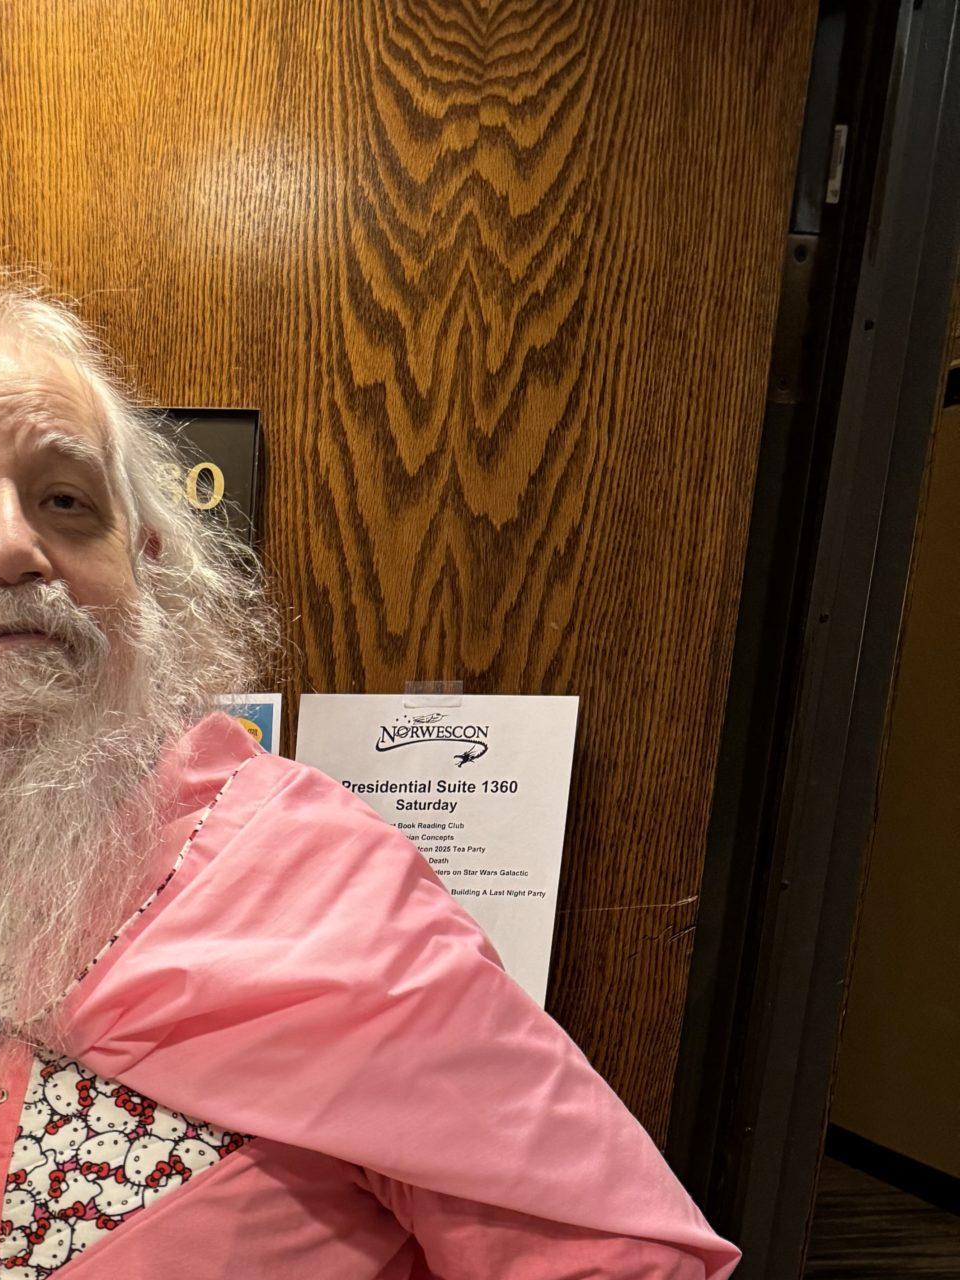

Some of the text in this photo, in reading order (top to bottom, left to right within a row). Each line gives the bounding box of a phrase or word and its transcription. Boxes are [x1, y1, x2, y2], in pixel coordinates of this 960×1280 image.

[380, 725, 489, 744] NORWESCON
[342, 780, 518, 794] Presidential Suite 1360
[396, 799, 458, 813] Saturday
[418, 822, 446, 830] Reading
[467, 846, 486, 854] Party
[500, 869, 529, 877] Galactic
[451, 889, 480, 897] Building
[507, 890, 526, 898] Night
[527, 890, 547, 899] Party
